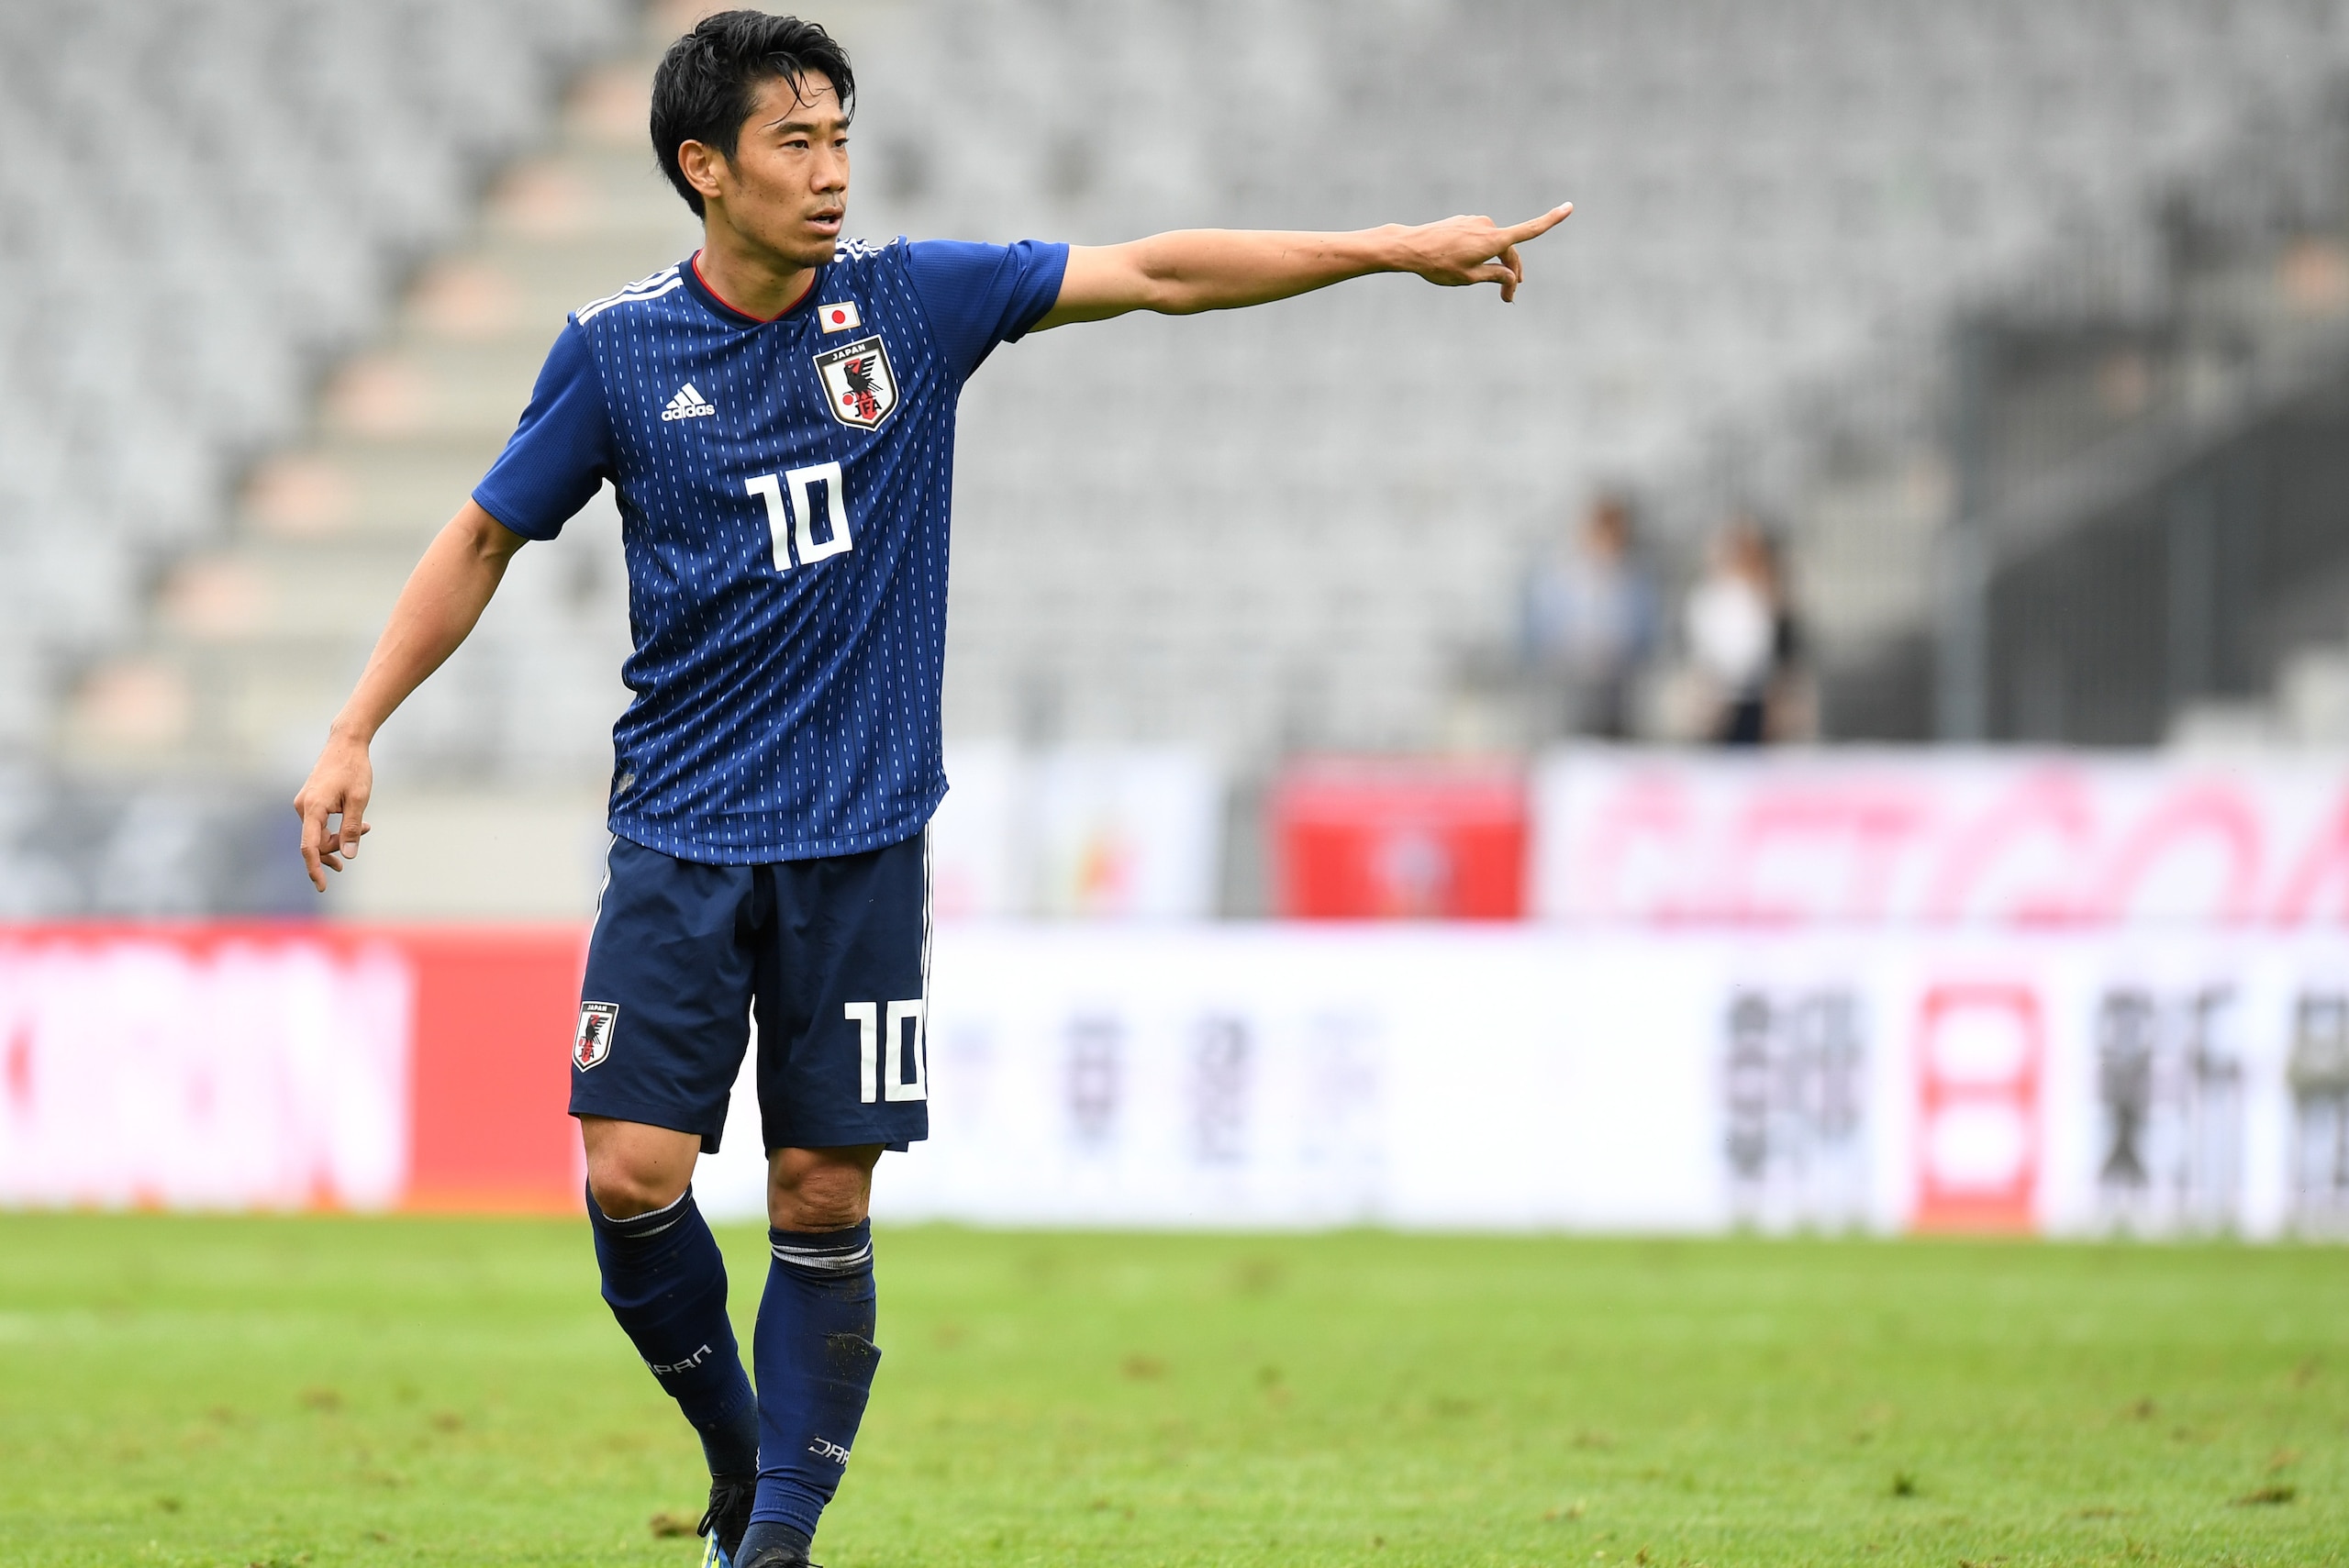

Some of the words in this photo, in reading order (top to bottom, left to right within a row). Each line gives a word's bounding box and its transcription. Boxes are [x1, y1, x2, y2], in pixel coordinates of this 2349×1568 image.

[832, 343, 866, 361] JAPAN
[661, 404, 716, 422] adidas
[854, 398, 883, 417] JFA
[744, 461, 853, 572] 10
[587, 1004, 608, 1012] JAPAN
[844, 998, 928, 1104] 10
